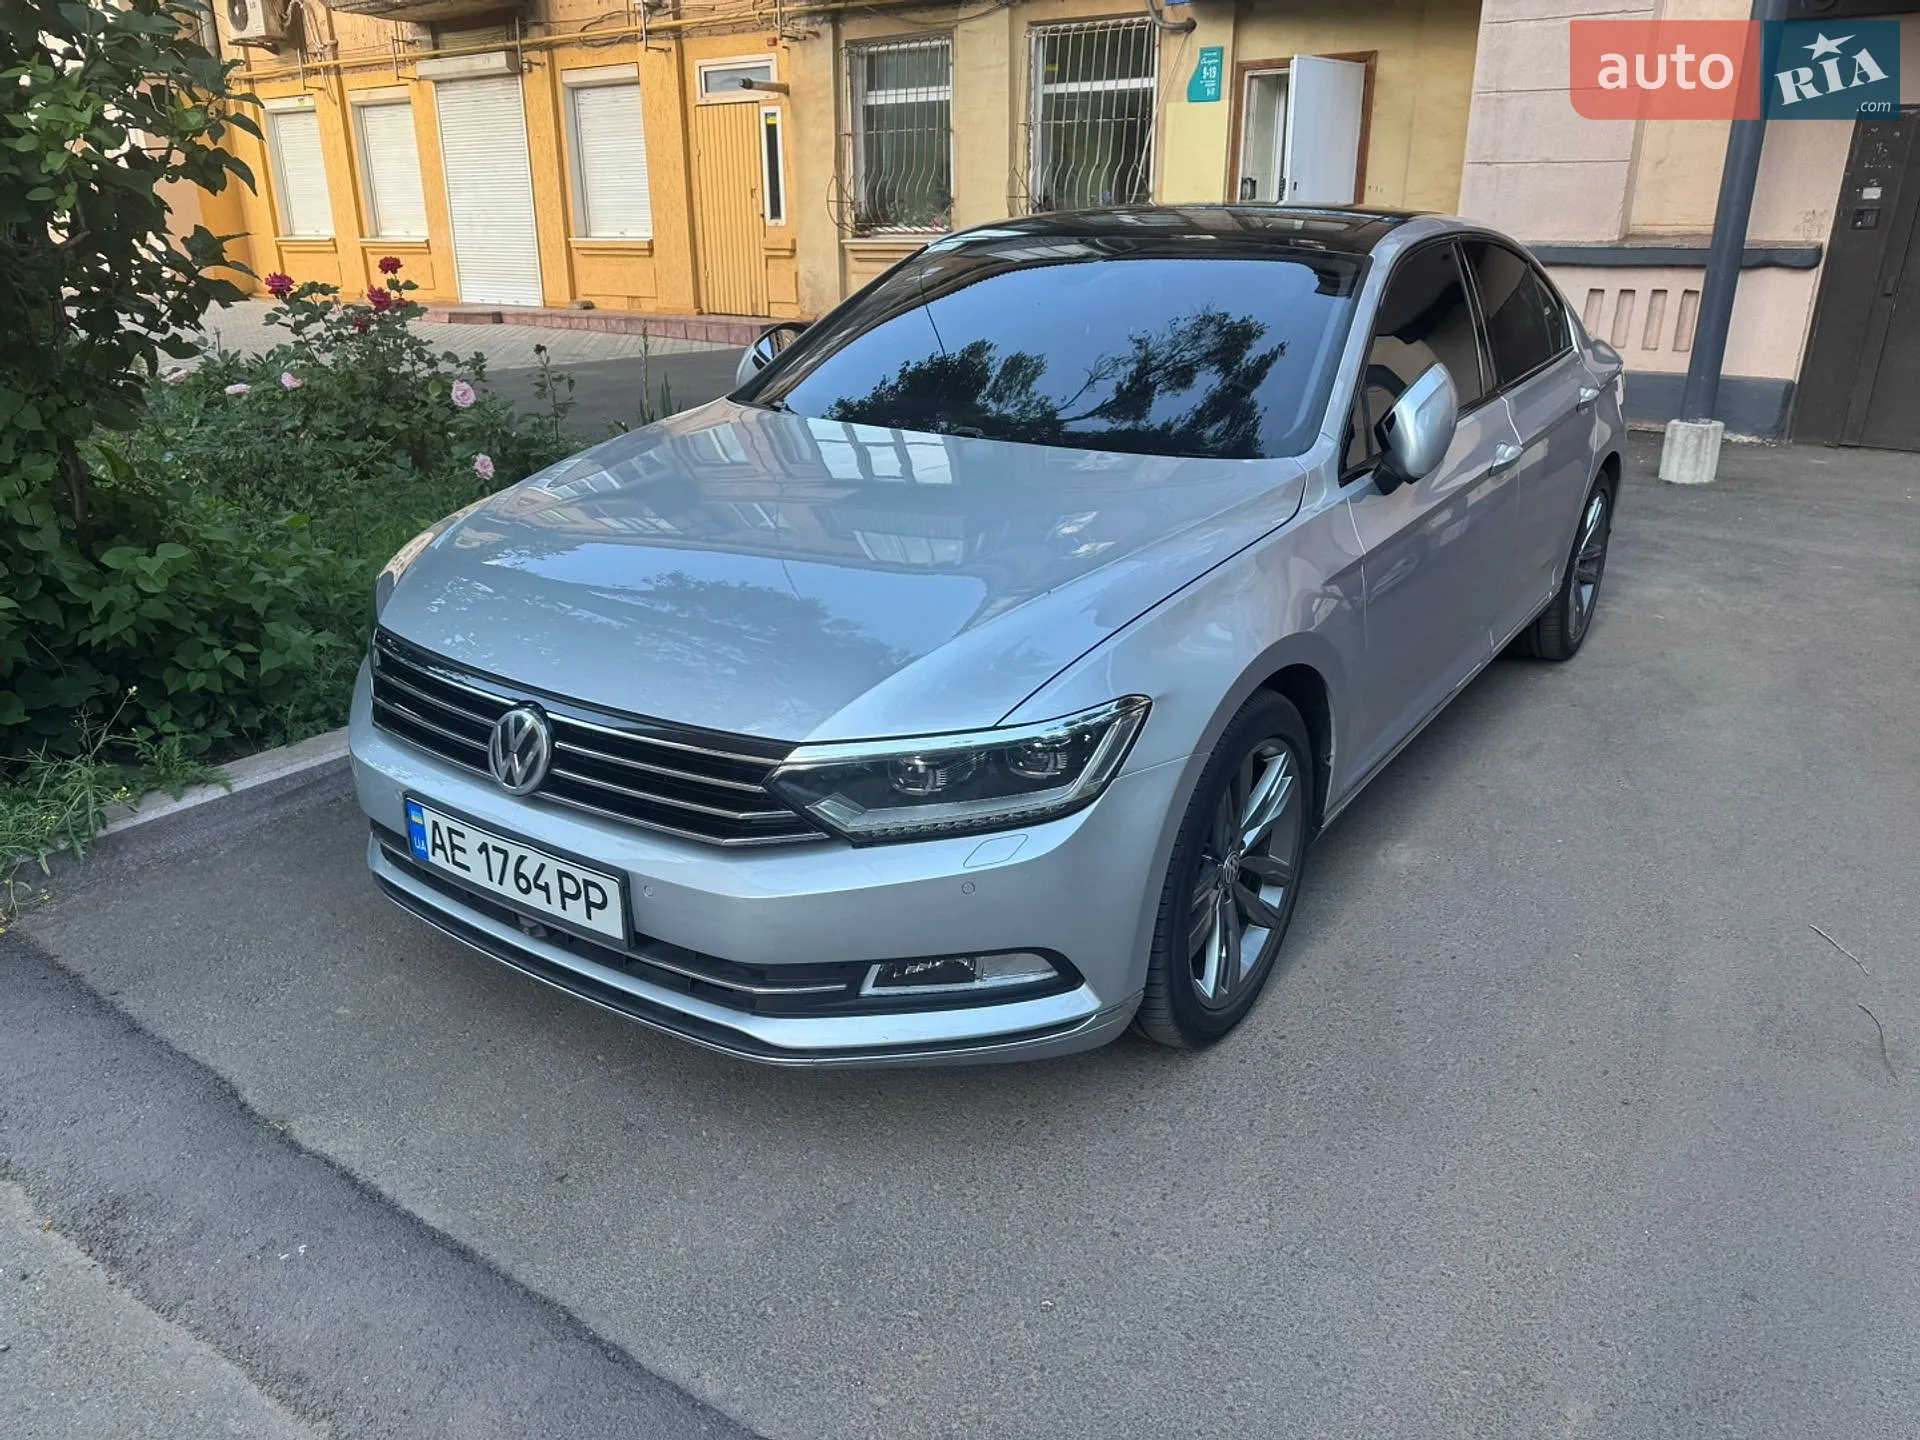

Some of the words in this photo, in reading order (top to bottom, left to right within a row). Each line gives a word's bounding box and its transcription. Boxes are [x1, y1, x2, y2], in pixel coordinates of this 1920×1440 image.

[414, 836, 427, 852] UA
[430, 820, 471, 872] AE
[478, 842, 552, 905] 1764
[556, 869, 608, 921] PP
